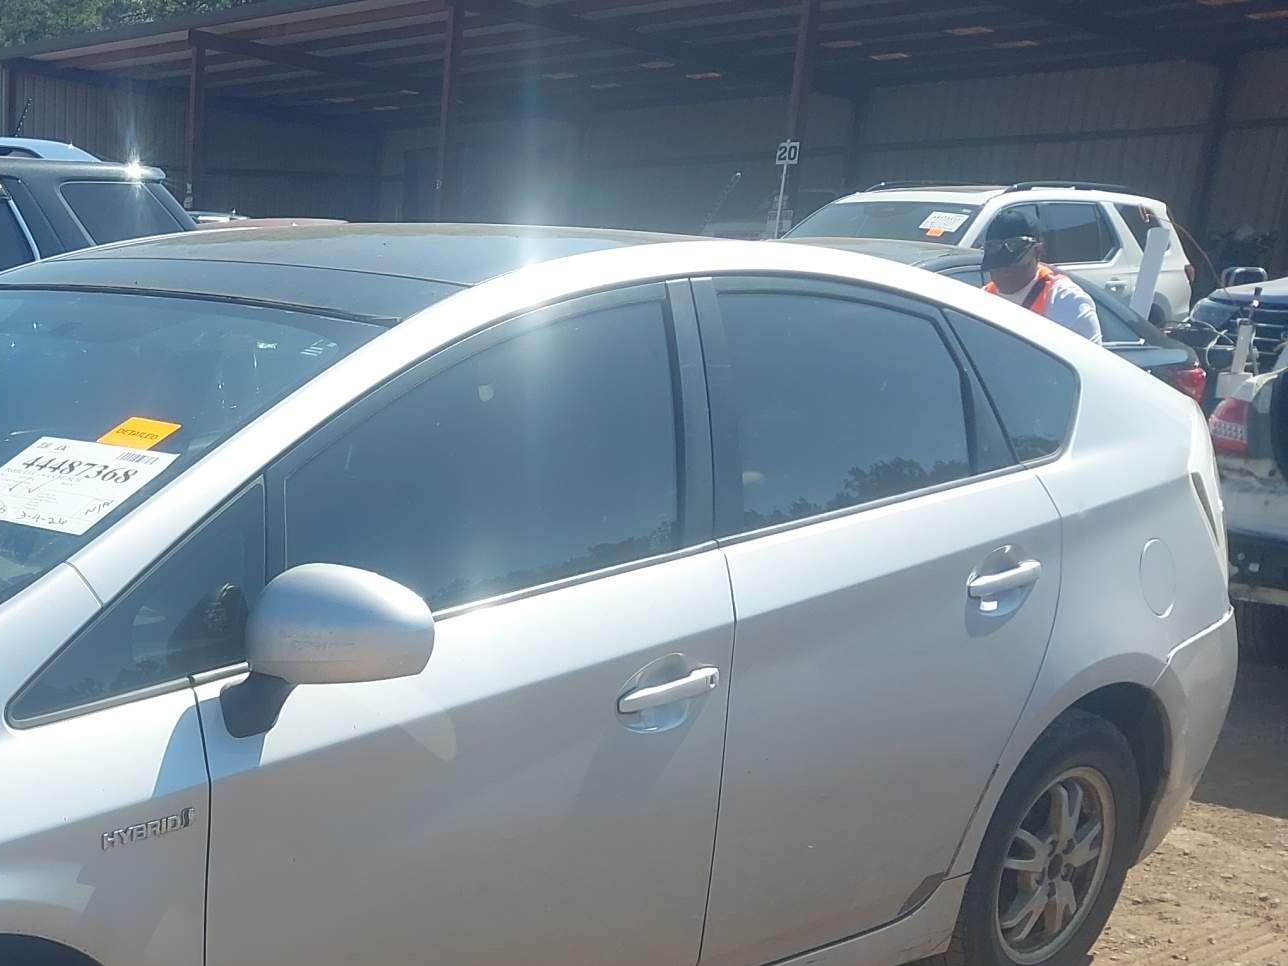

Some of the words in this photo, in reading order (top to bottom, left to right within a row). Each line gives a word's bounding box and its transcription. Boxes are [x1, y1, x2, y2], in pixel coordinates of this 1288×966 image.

[778, 145, 798, 161] 20
[23, 455, 139, 484] 44487368
[101, 814, 180, 851] HYBRID
